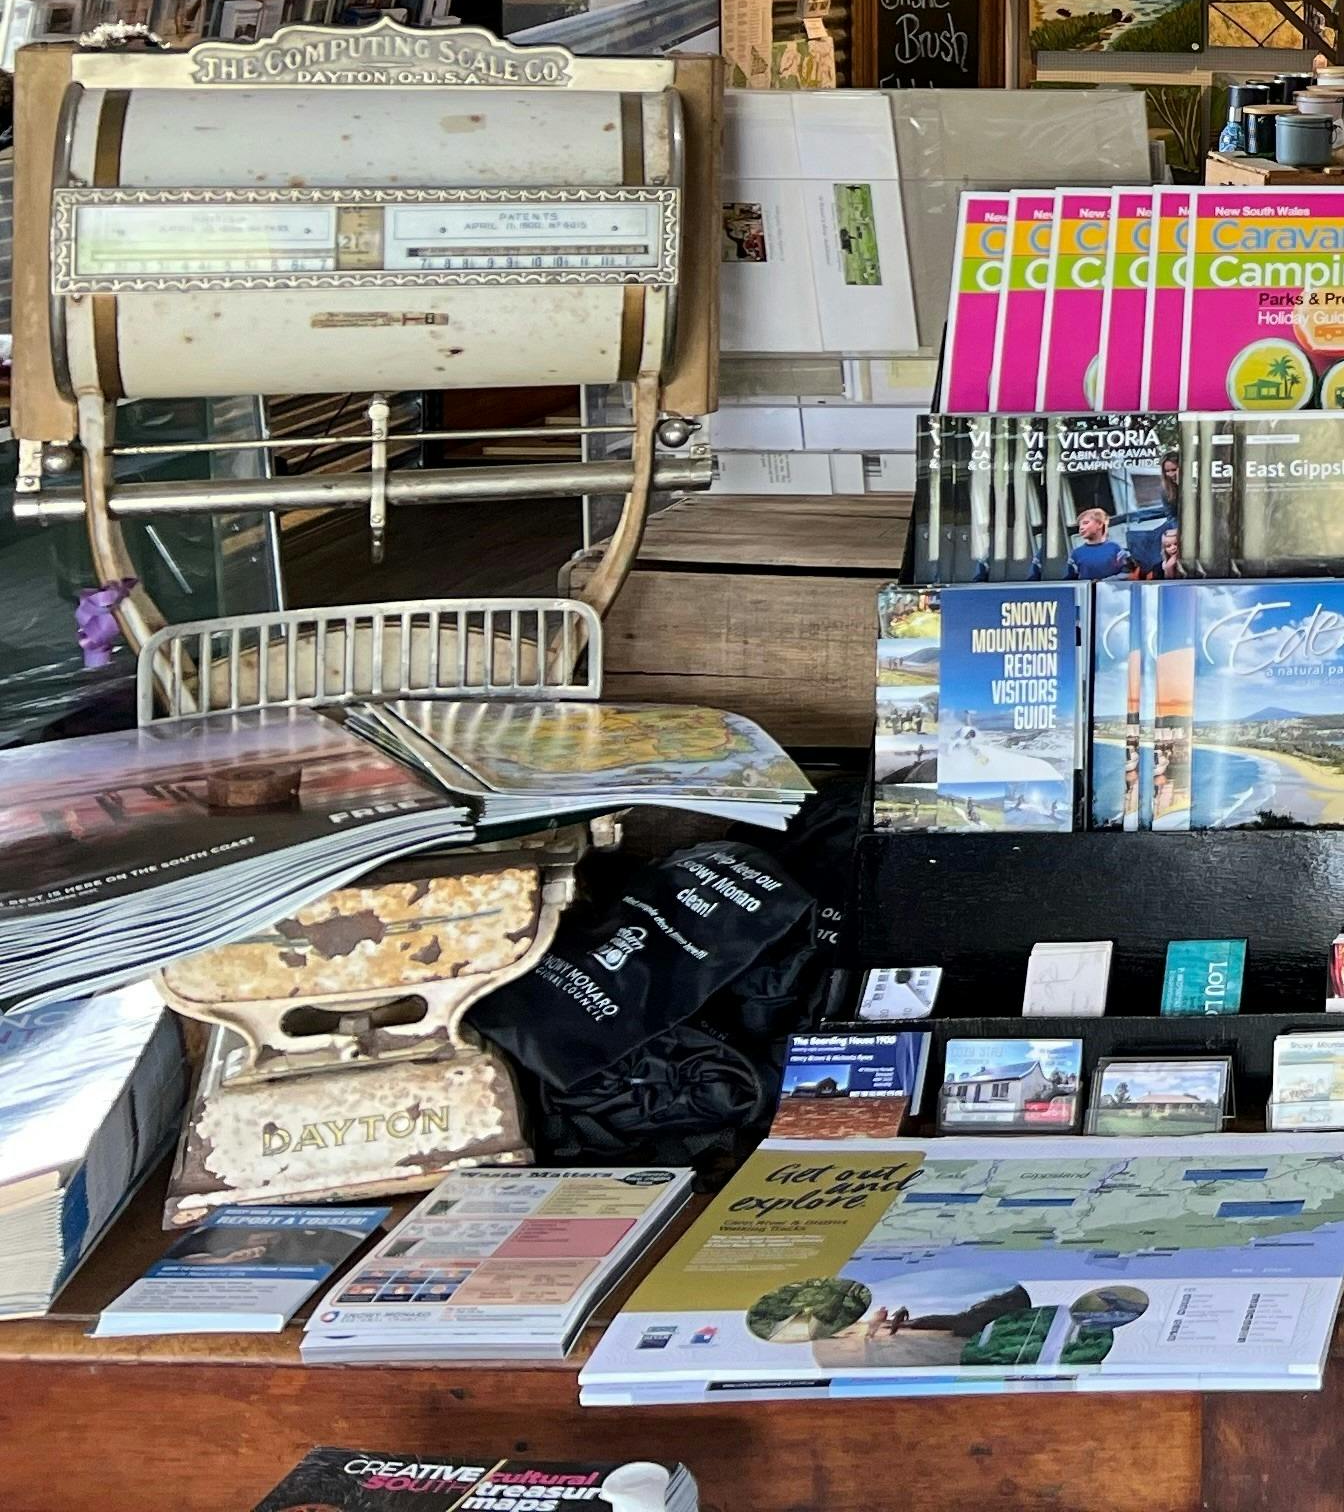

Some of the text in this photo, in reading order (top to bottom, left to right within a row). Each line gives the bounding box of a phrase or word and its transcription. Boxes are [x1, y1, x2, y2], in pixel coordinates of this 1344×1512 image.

[895, 13, 968, 72] Brush
[201, 57, 259, 82] THE
[265, 36, 431, 75] COMPUTING
[438, 41, 518, 81] SCALE
[1079, 208, 1106, 219] New
[1215, 206, 1310, 216] New South Wales
[1258, 292, 1304, 305] Parks
[1309, 292, 1320, 305] &
[1258, 310, 1310, 327] Holiday
[1057, 429, 1160, 449] VICTORIA
[1056, 458, 1160, 472] & CAMPING GUIDE
[1101, 448, 1157, 460] CARAVAN
[1246, 460, 1285, 478] East
[1001, 601, 1057, 626] SNOWY
[972, 627, 1057, 653] MOUNTAINS
[1004, 653, 1057, 678] REGION
[1266, 668, 1273, 677] a
[1278, 665, 1324, 676] natural
[992, 679, 1057, 704] VISITORS
[1014, 705, 1056, 729] GUIDE
[327, 799, 421, 825] FREE
[64, 879, 103, 894] HERE
[105, 873, 128, 883] ON
[130, 865, 158, 878] THE
[161, 850, 208, 869] SOUTH
[210, 835, 255, 855] COAST
[733, 858, 783, 891] keep our
[676, 888, 719, 918] clean!
[715, 876, 762, 912] Monaro
[567, 965, 621, 1017] MONARO
[1205, 961, 1228, 998] LOU
[562, 983, 605, 1022] COUNCIL
[792, 1037, 809, 1046] The
[848, 1036, 875, 1045] House
[262, 1105, 452, 1158] DAYTON
[765, 1162, 908, 1185] Get out
[828, 1170, 924, 1194] and
[1020, 1171, 1090, 1182] Gippsland
[214, 1215, 368, 1226] REPORT A TOSSER!
[344, 1459, 485, 1483] CREATIVE
[486, 1470, 599, 1486] cultural
[361, 1476, 474, 1495] SOUTH
[461, 1497, 560, 1512] maps
